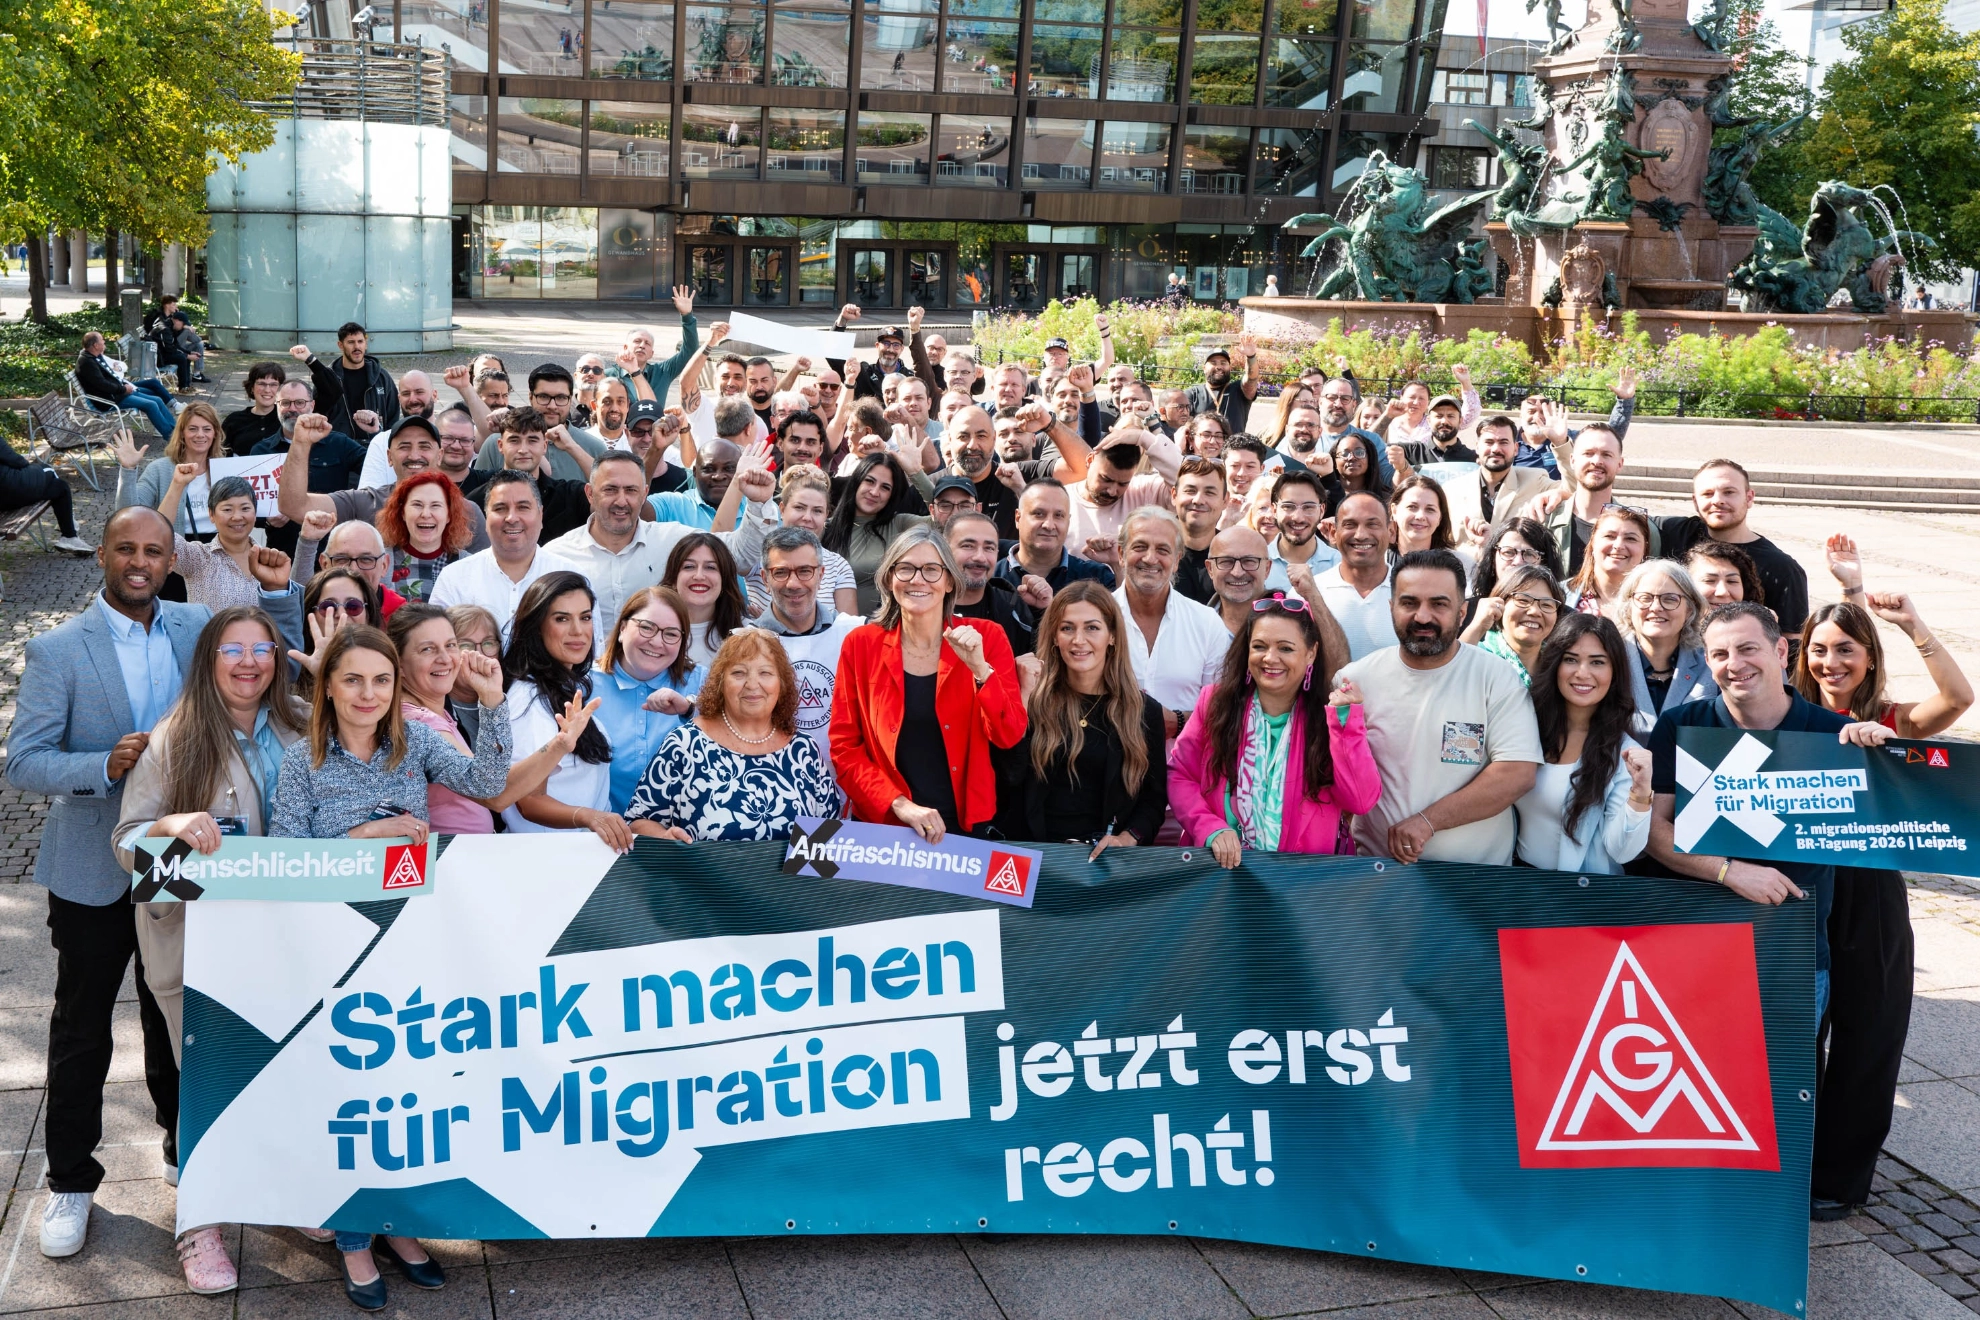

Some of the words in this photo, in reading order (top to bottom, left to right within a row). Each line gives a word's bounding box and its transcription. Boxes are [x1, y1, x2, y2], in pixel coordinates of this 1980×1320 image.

[1714, 774, 1770, 791] Stark
[1775, 772, 1861, 790] machen
[1714, 795, 1744, 812] für
[1751, 793, 1854, 814] Migration
[1794, 823, 1808, 836] 2.
[1810, 820, 1950, 837] migrationspolitische
[1796, 837, 1867, 851] BR-Tagung
[1869, 836, 1906, 849] 2026
[1917, 835, 1967, 851] Leipzig
[153, 850, 376, 882] Menschlichkeit
[789, 835, 983, 876] Antifaschismus
[328, 964, 593, 1071] Stark
[623, 936, 976, 1033] machen
[989, 1012, 1199, 1121] jetzt
[1227, 1006, 1413, 1086] erst
[328, 1092, 470, 1171] für
[502, 1037, 942, 1158] Migration
[1004, 1109, 1276, 1202] recht!
